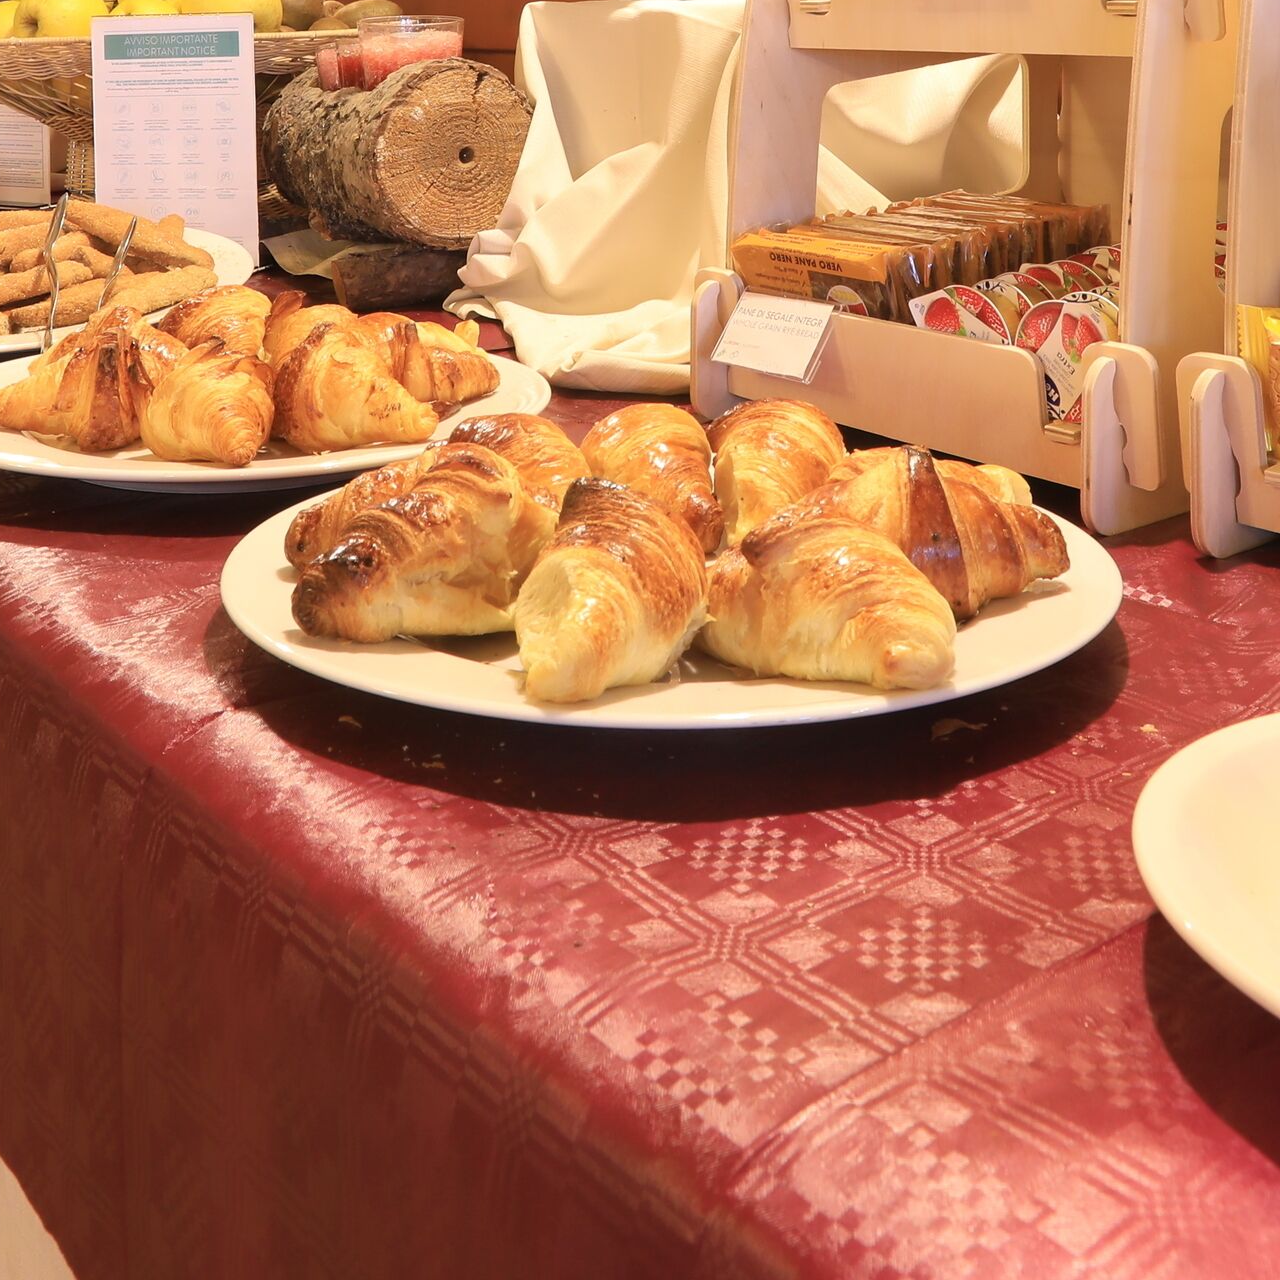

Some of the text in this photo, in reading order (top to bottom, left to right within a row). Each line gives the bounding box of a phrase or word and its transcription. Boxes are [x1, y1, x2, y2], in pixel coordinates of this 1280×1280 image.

[124, 33, 219, 46] AVVISO IMPORTANTE
[126, 45, 216, 57] IMPORTANT NOTICE
[770, 251, 793, 264] NERO
[795, 257, 817, 269] PANE
[820, 260, 843, 273] VERO
[738, 306, 756, 317] PANE
[756, 308, 766, 317] DI
[765, 310, 794, 323] SEGALE
[1056, 351, 1076, 376] Extra
